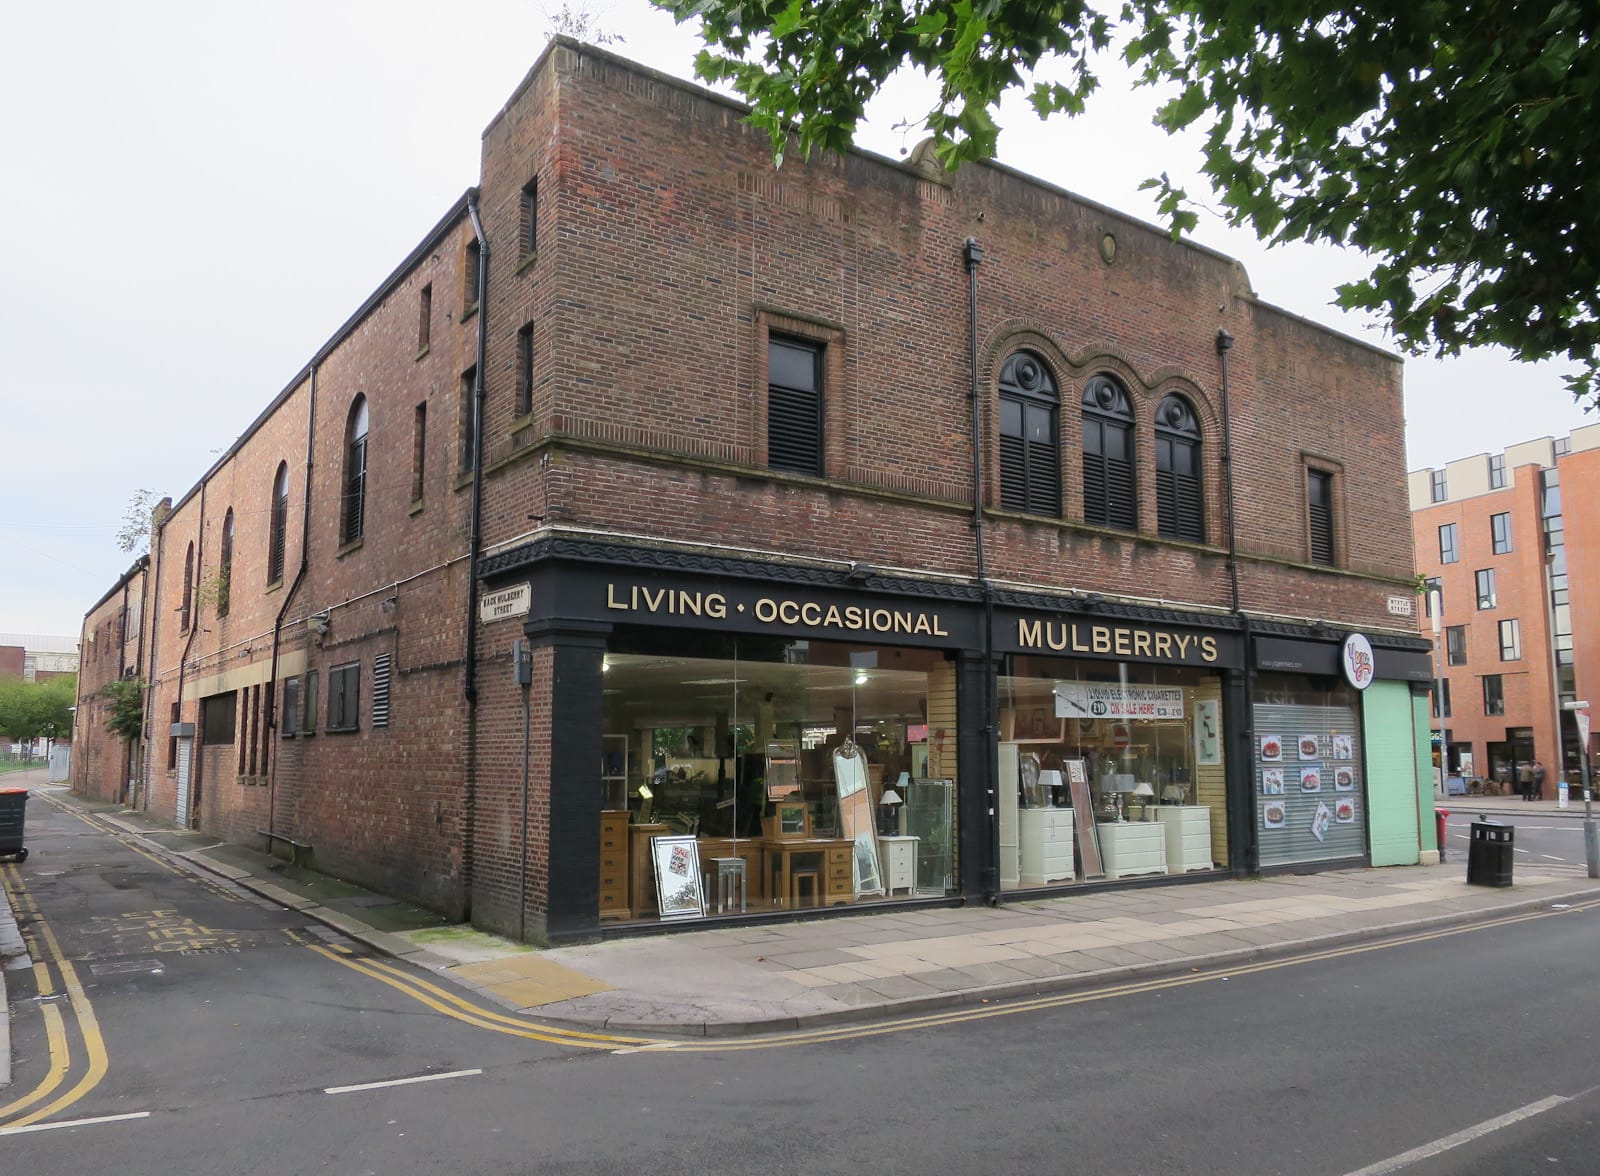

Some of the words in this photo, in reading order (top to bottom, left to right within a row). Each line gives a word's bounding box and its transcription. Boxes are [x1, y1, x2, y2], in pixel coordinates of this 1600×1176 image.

[483, 596, 497, 609] BACK
[497, 589, 524, 604] MULBERRY
[1390, 599, 1409, 607] MYRTLE
[493, 603, 513, 616] STREET
[607, 583, 727, 619] LIVING
[755, 598, 949, 636] OCCASIONAL
[1390, 606, 1409, 614] STREET
[1018, 618, 1218, 662] MULBERRY'S
[1089, 688, 1109, 699] LIQUID
[1148, 690, 1182, 701] CIGARETTES
[1110, 703, 1120, 714] ON
[1121, 703, 1137, 714] SALE
[1138, 703, 1155, 714] HERE
